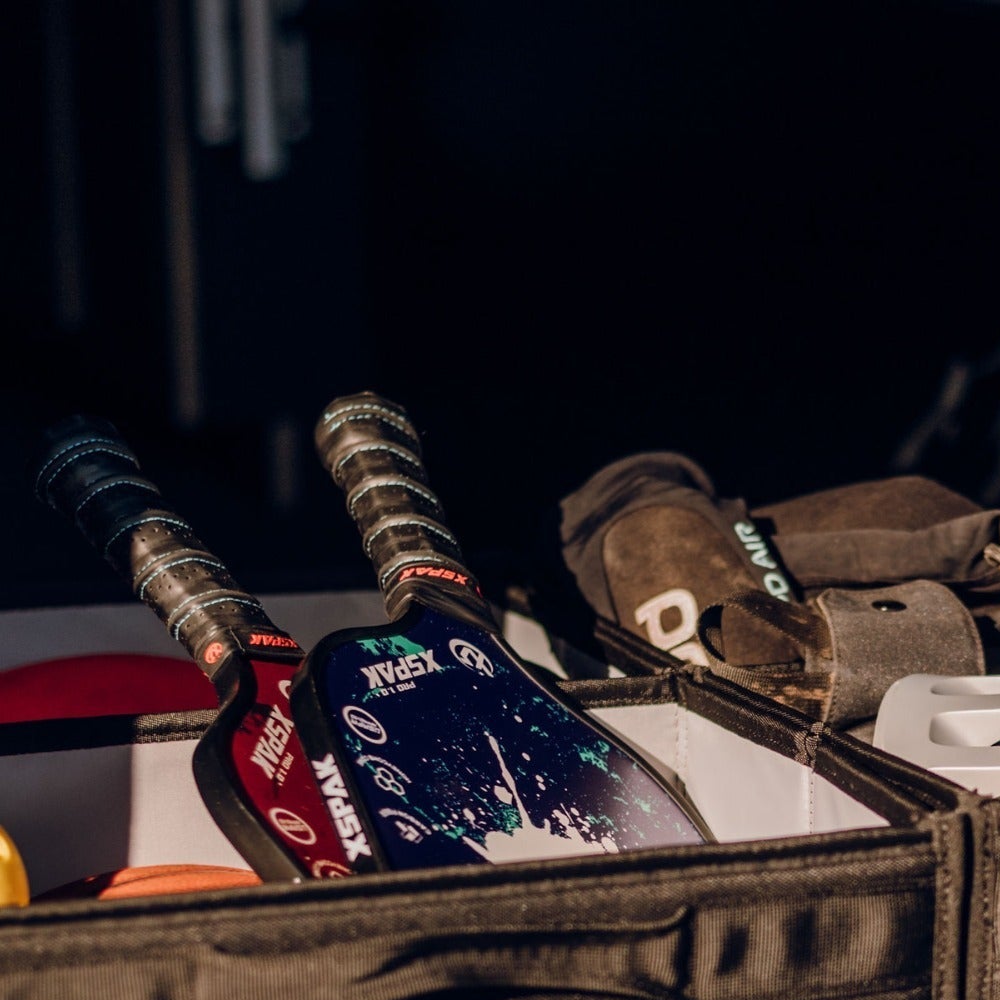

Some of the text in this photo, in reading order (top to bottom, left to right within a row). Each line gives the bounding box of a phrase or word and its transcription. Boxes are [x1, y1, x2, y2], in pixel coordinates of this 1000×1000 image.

[733, 521, 777, 569] AIR
[399, 567, 468, 585] XSPAK
[250, 633, 299, 648] XSPAK
[360, 649, 443, 690] XSPAK
[396, 680, 416, 692] PRO
[250, 704, 294, 780] XSPAK
[282, 752, 294, 770] PRO
[311, 753, 372, 862] XSPAK
